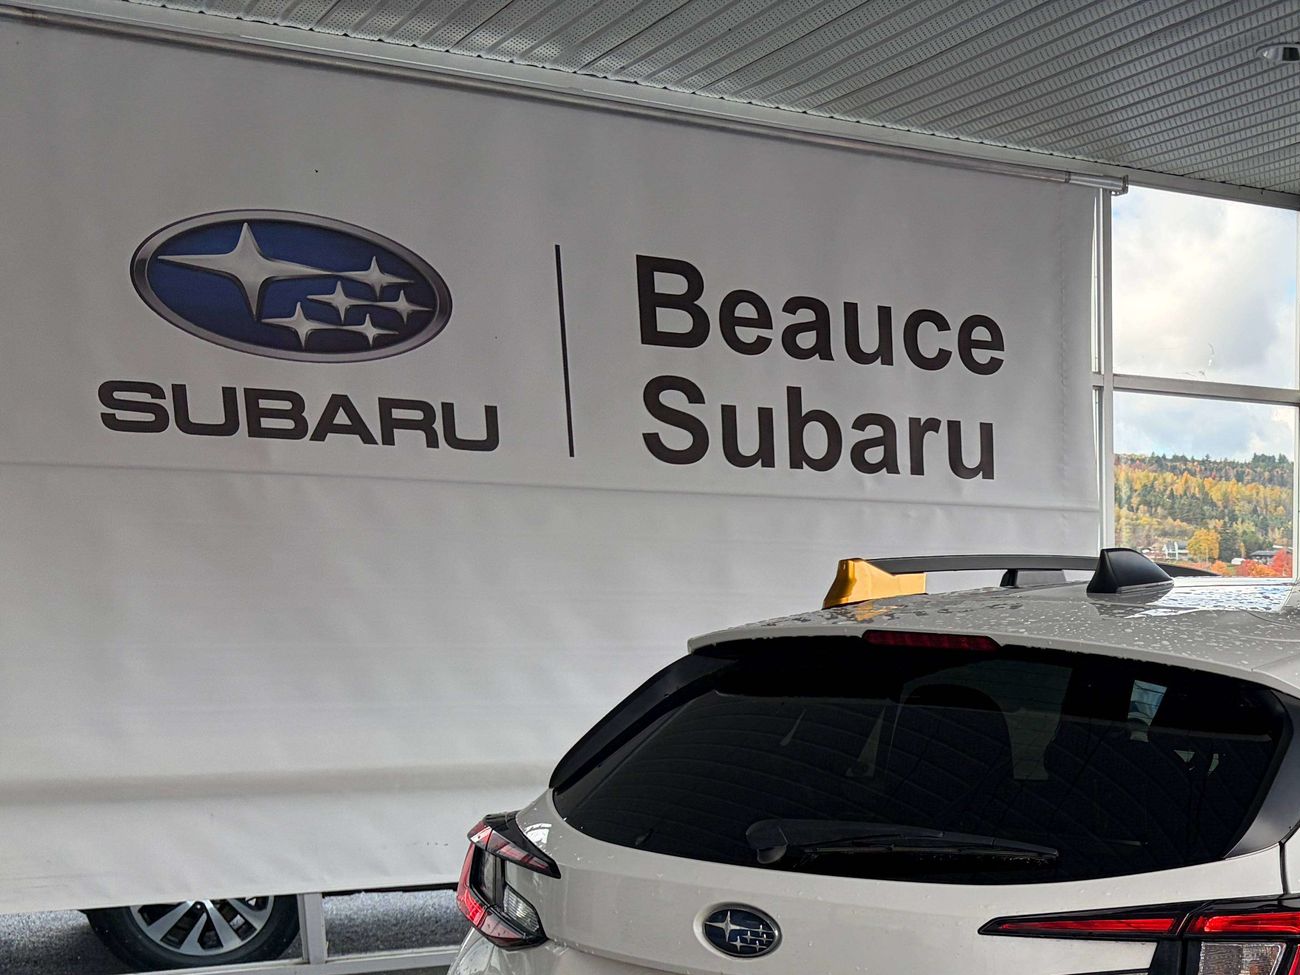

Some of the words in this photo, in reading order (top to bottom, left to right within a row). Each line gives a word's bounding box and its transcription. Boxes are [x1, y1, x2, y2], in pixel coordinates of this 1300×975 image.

[636, 254, 1005, 376] Beauce
[98, 380, 500, 452] SUBARU
[642, 374, 995, 480] Subaru
